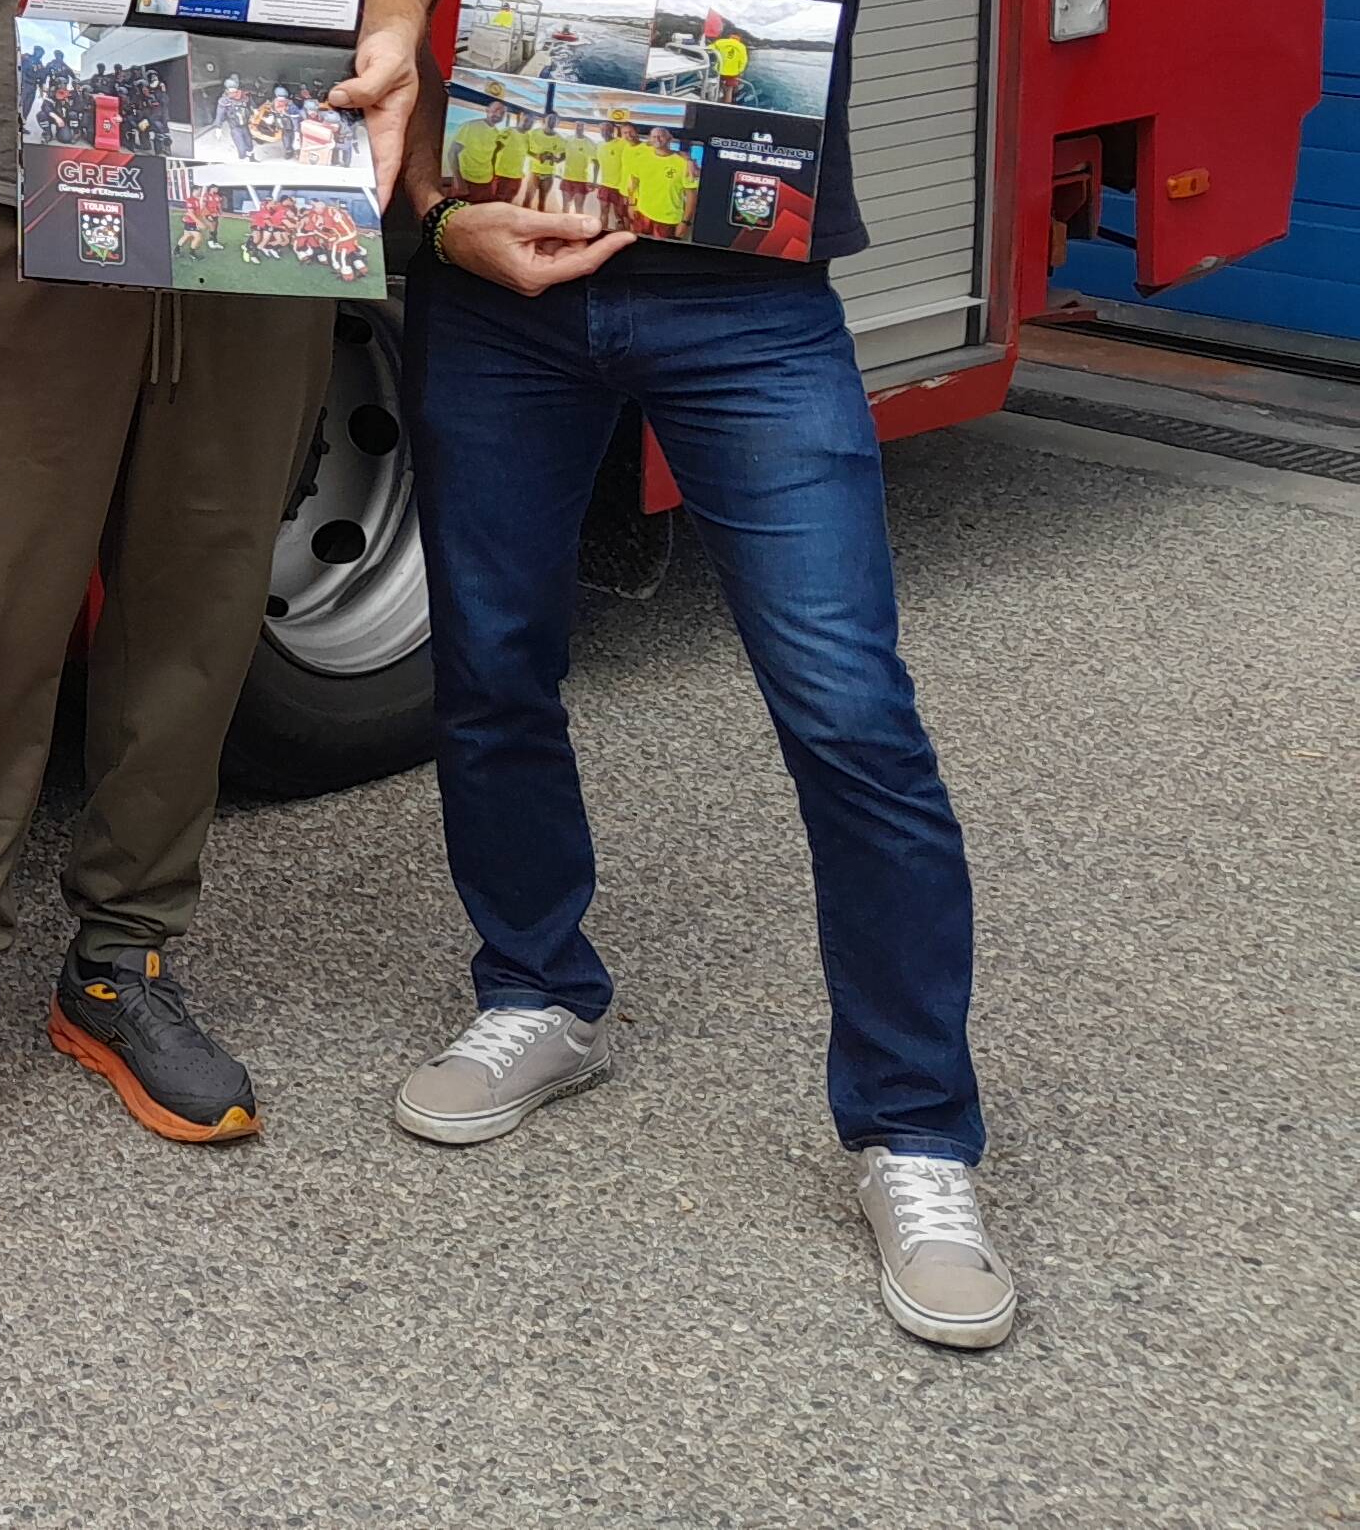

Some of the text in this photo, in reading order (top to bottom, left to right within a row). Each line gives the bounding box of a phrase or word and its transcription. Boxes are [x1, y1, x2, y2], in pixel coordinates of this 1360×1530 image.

[752, 131, 773, 143] LA
[58, 160, 142, 190] GREX
[83, 202, 119, 213] TOULON
